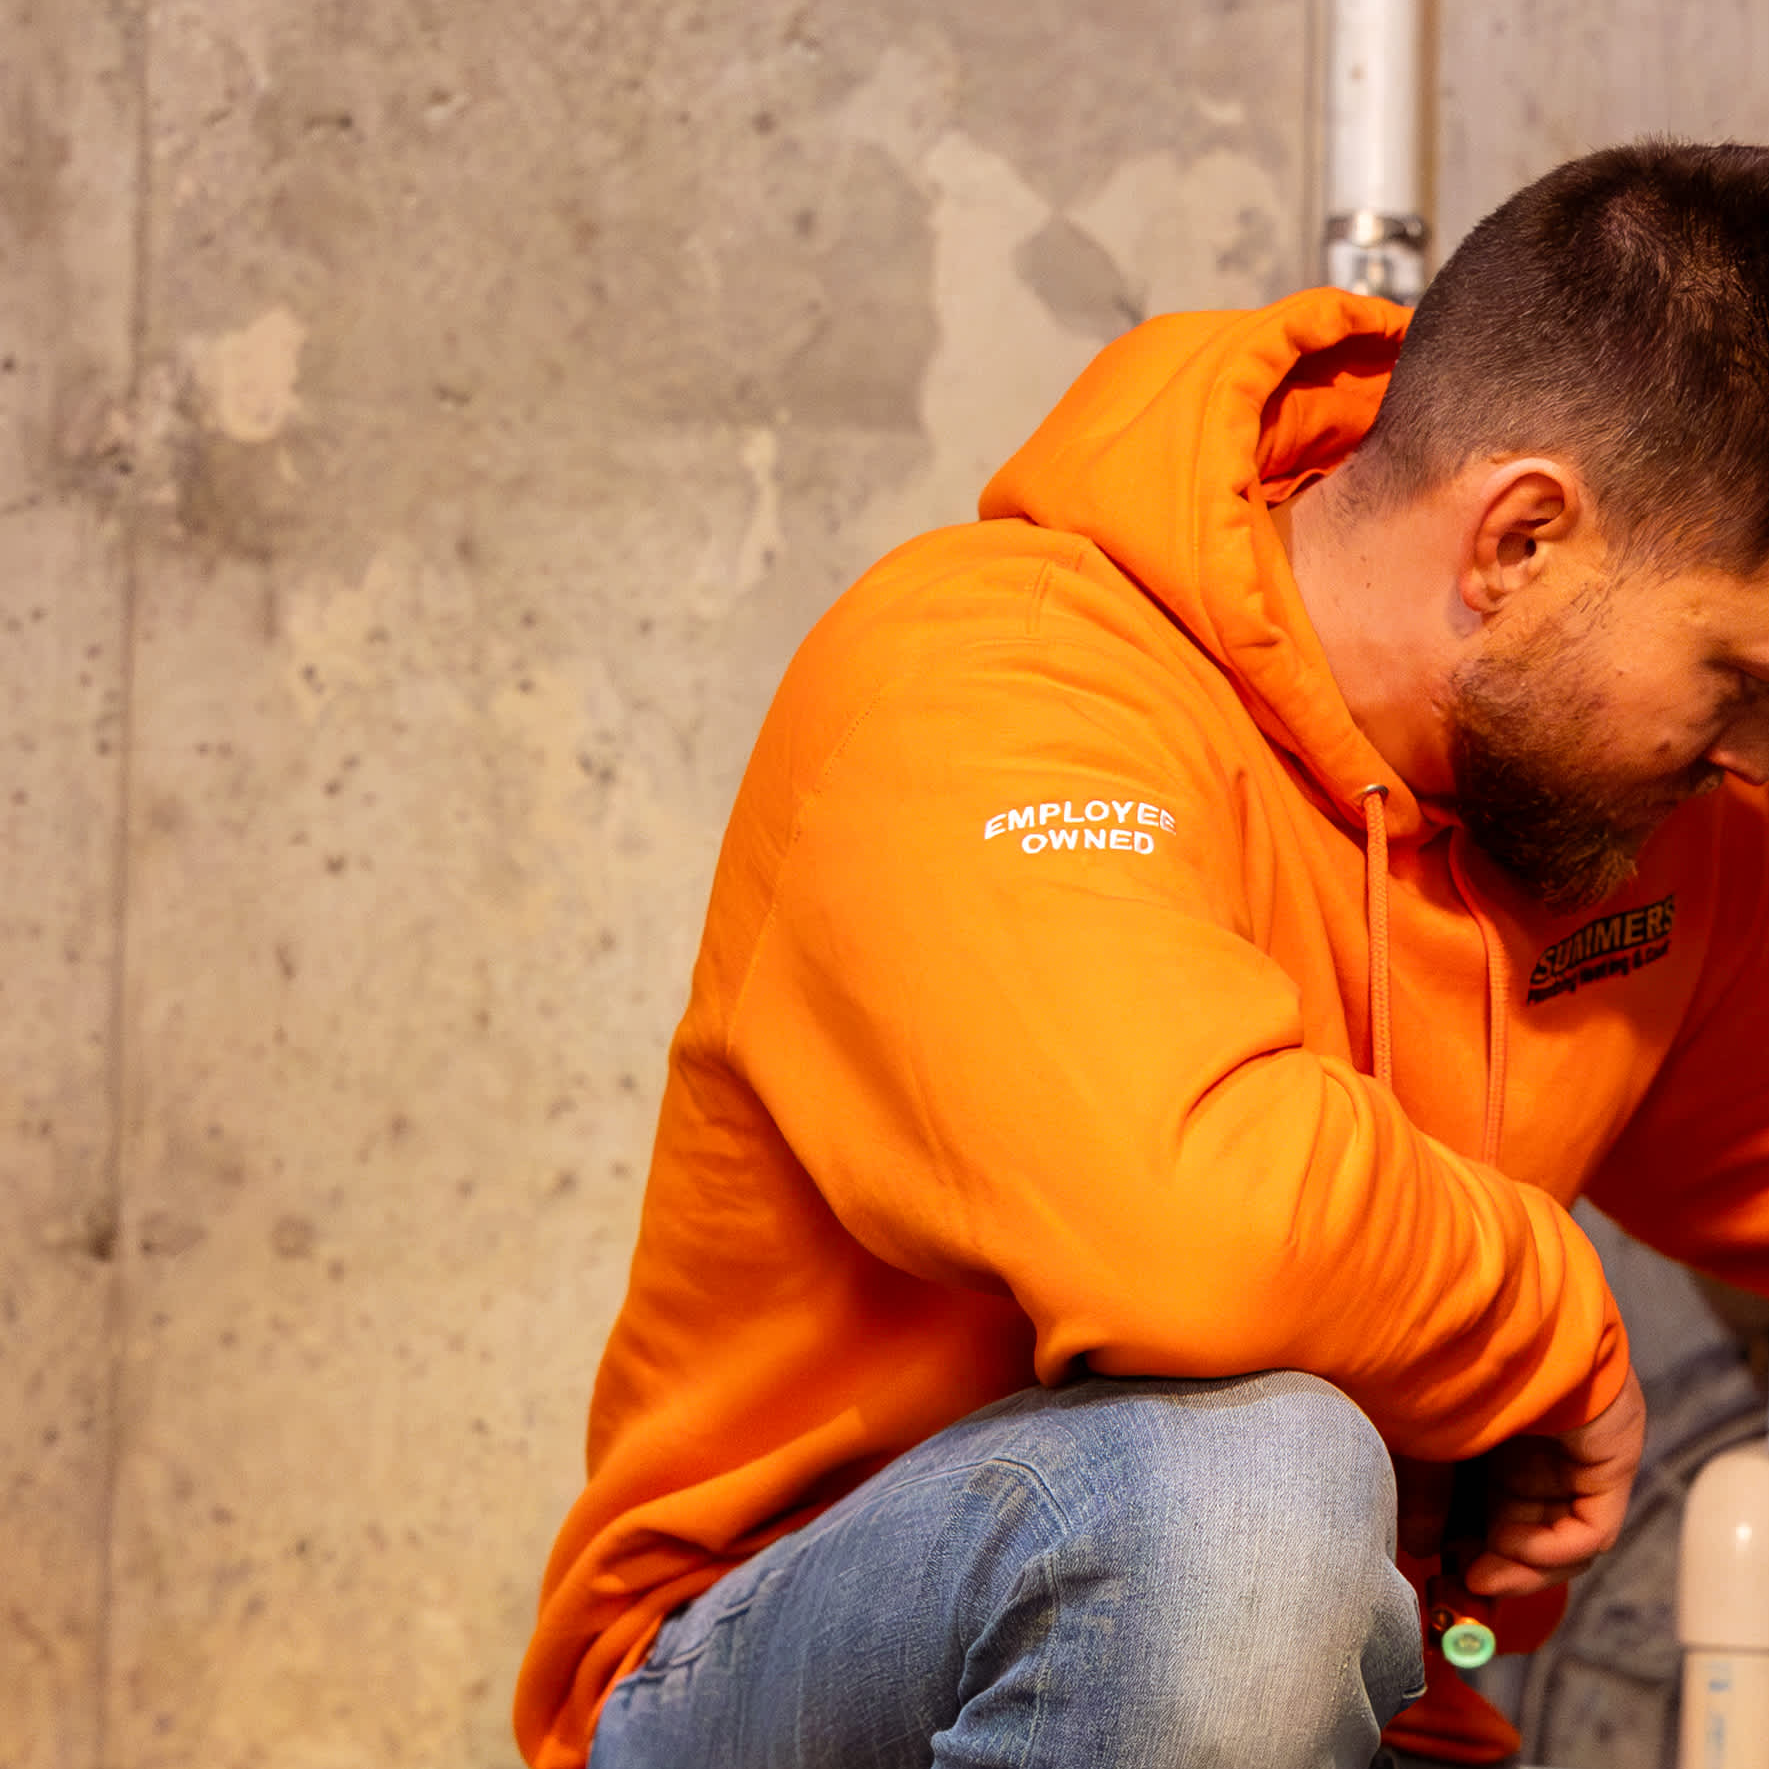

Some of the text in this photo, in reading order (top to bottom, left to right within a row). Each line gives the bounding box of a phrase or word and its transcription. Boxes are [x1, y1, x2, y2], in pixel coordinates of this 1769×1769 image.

[984, 799, 1177, 840] EMPLOYEE
[1021, 828, 1155, 855] OWNED
[1530, 899, 1675, 986] SUMMERS
